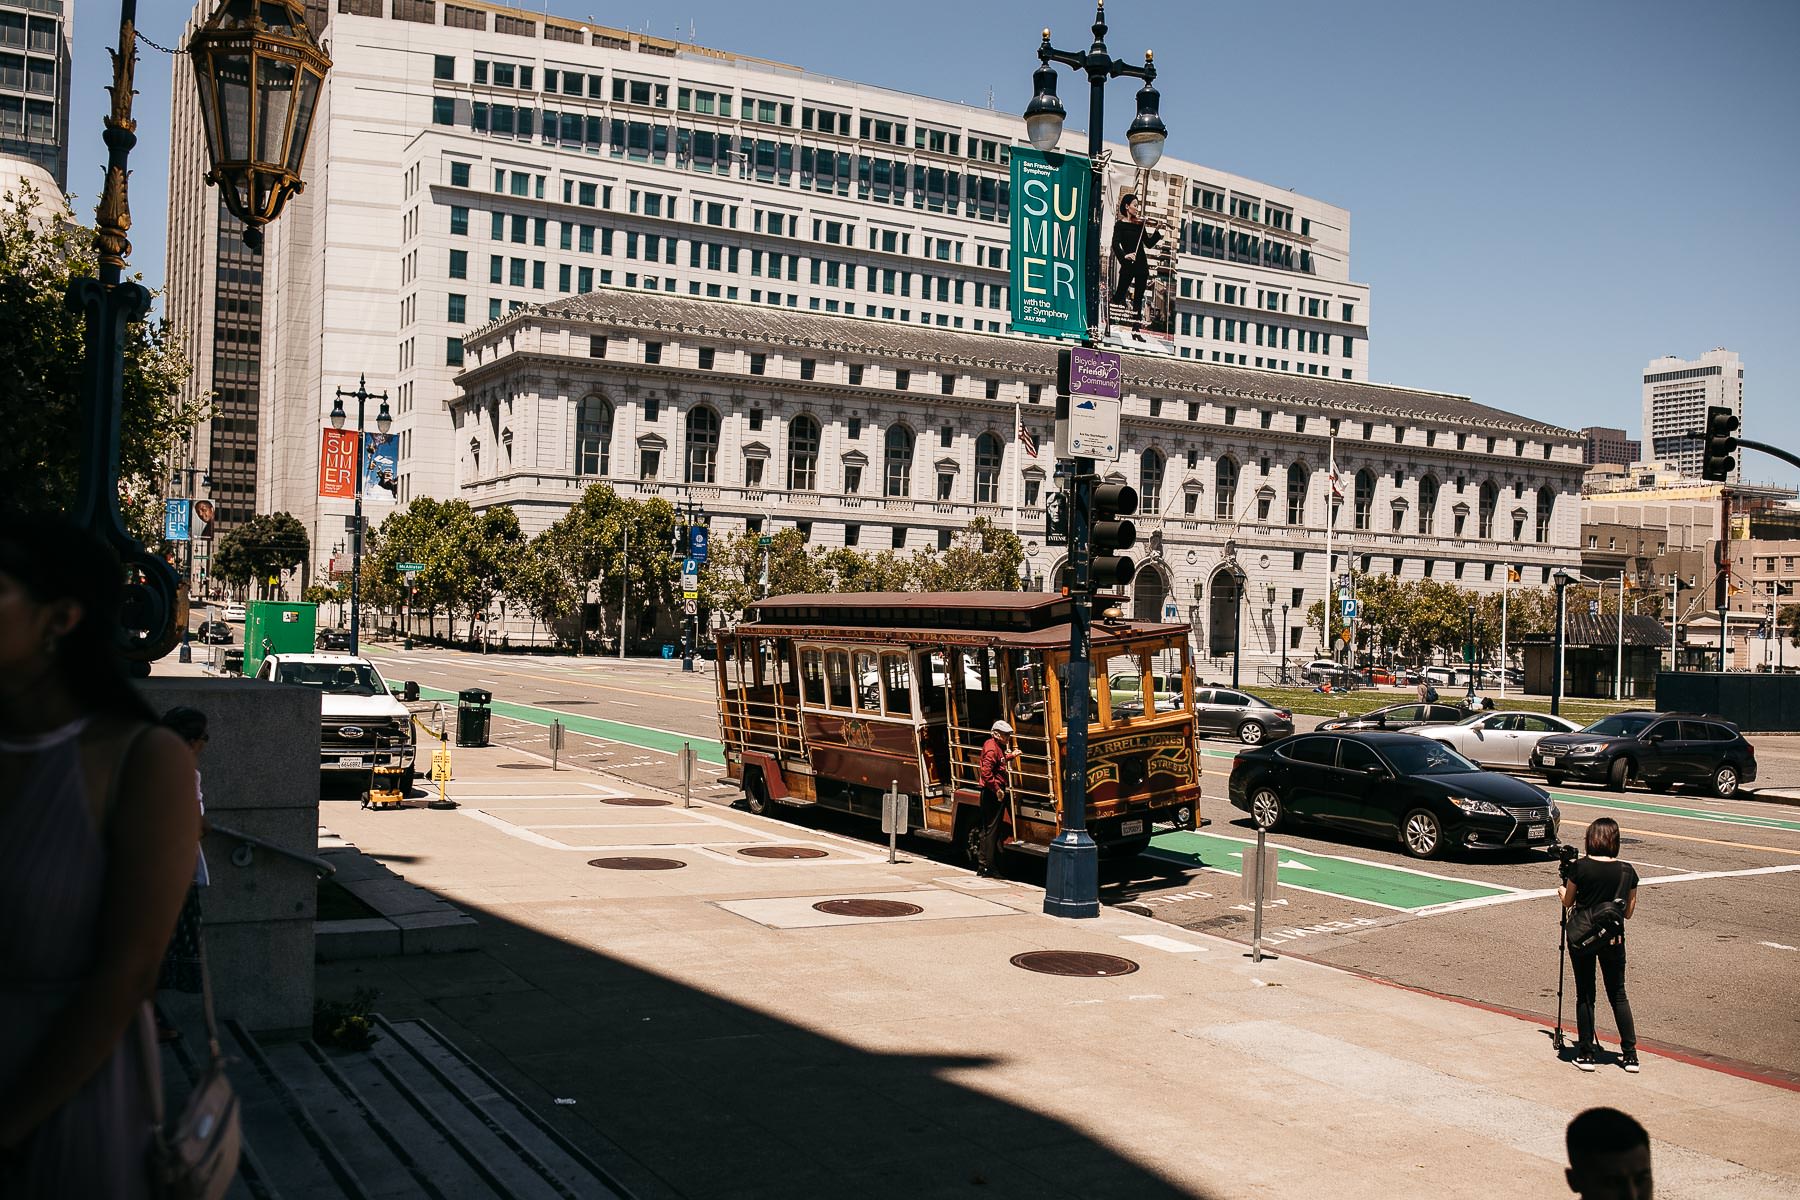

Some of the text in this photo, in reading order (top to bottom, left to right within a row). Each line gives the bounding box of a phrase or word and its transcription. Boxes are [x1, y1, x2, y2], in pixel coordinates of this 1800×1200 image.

[1023, 167, 1051, 178] Symphony
[1034, 162, 1060, 172] Francisco
[1023, 298, 1051, 309] with the
[1023, 305, 1069, 321] SF Symphony
[1074, 355, 1097, 367] Bicycle
[1078, 365, 1110, 379] Friendly
[1081, 375, 1118, 390] Community
[1149, 735, 1183, 748] JONES
[1151, 759, 1188, 774] STREETS
[1260, 917, 1378, 945] PERMIT
